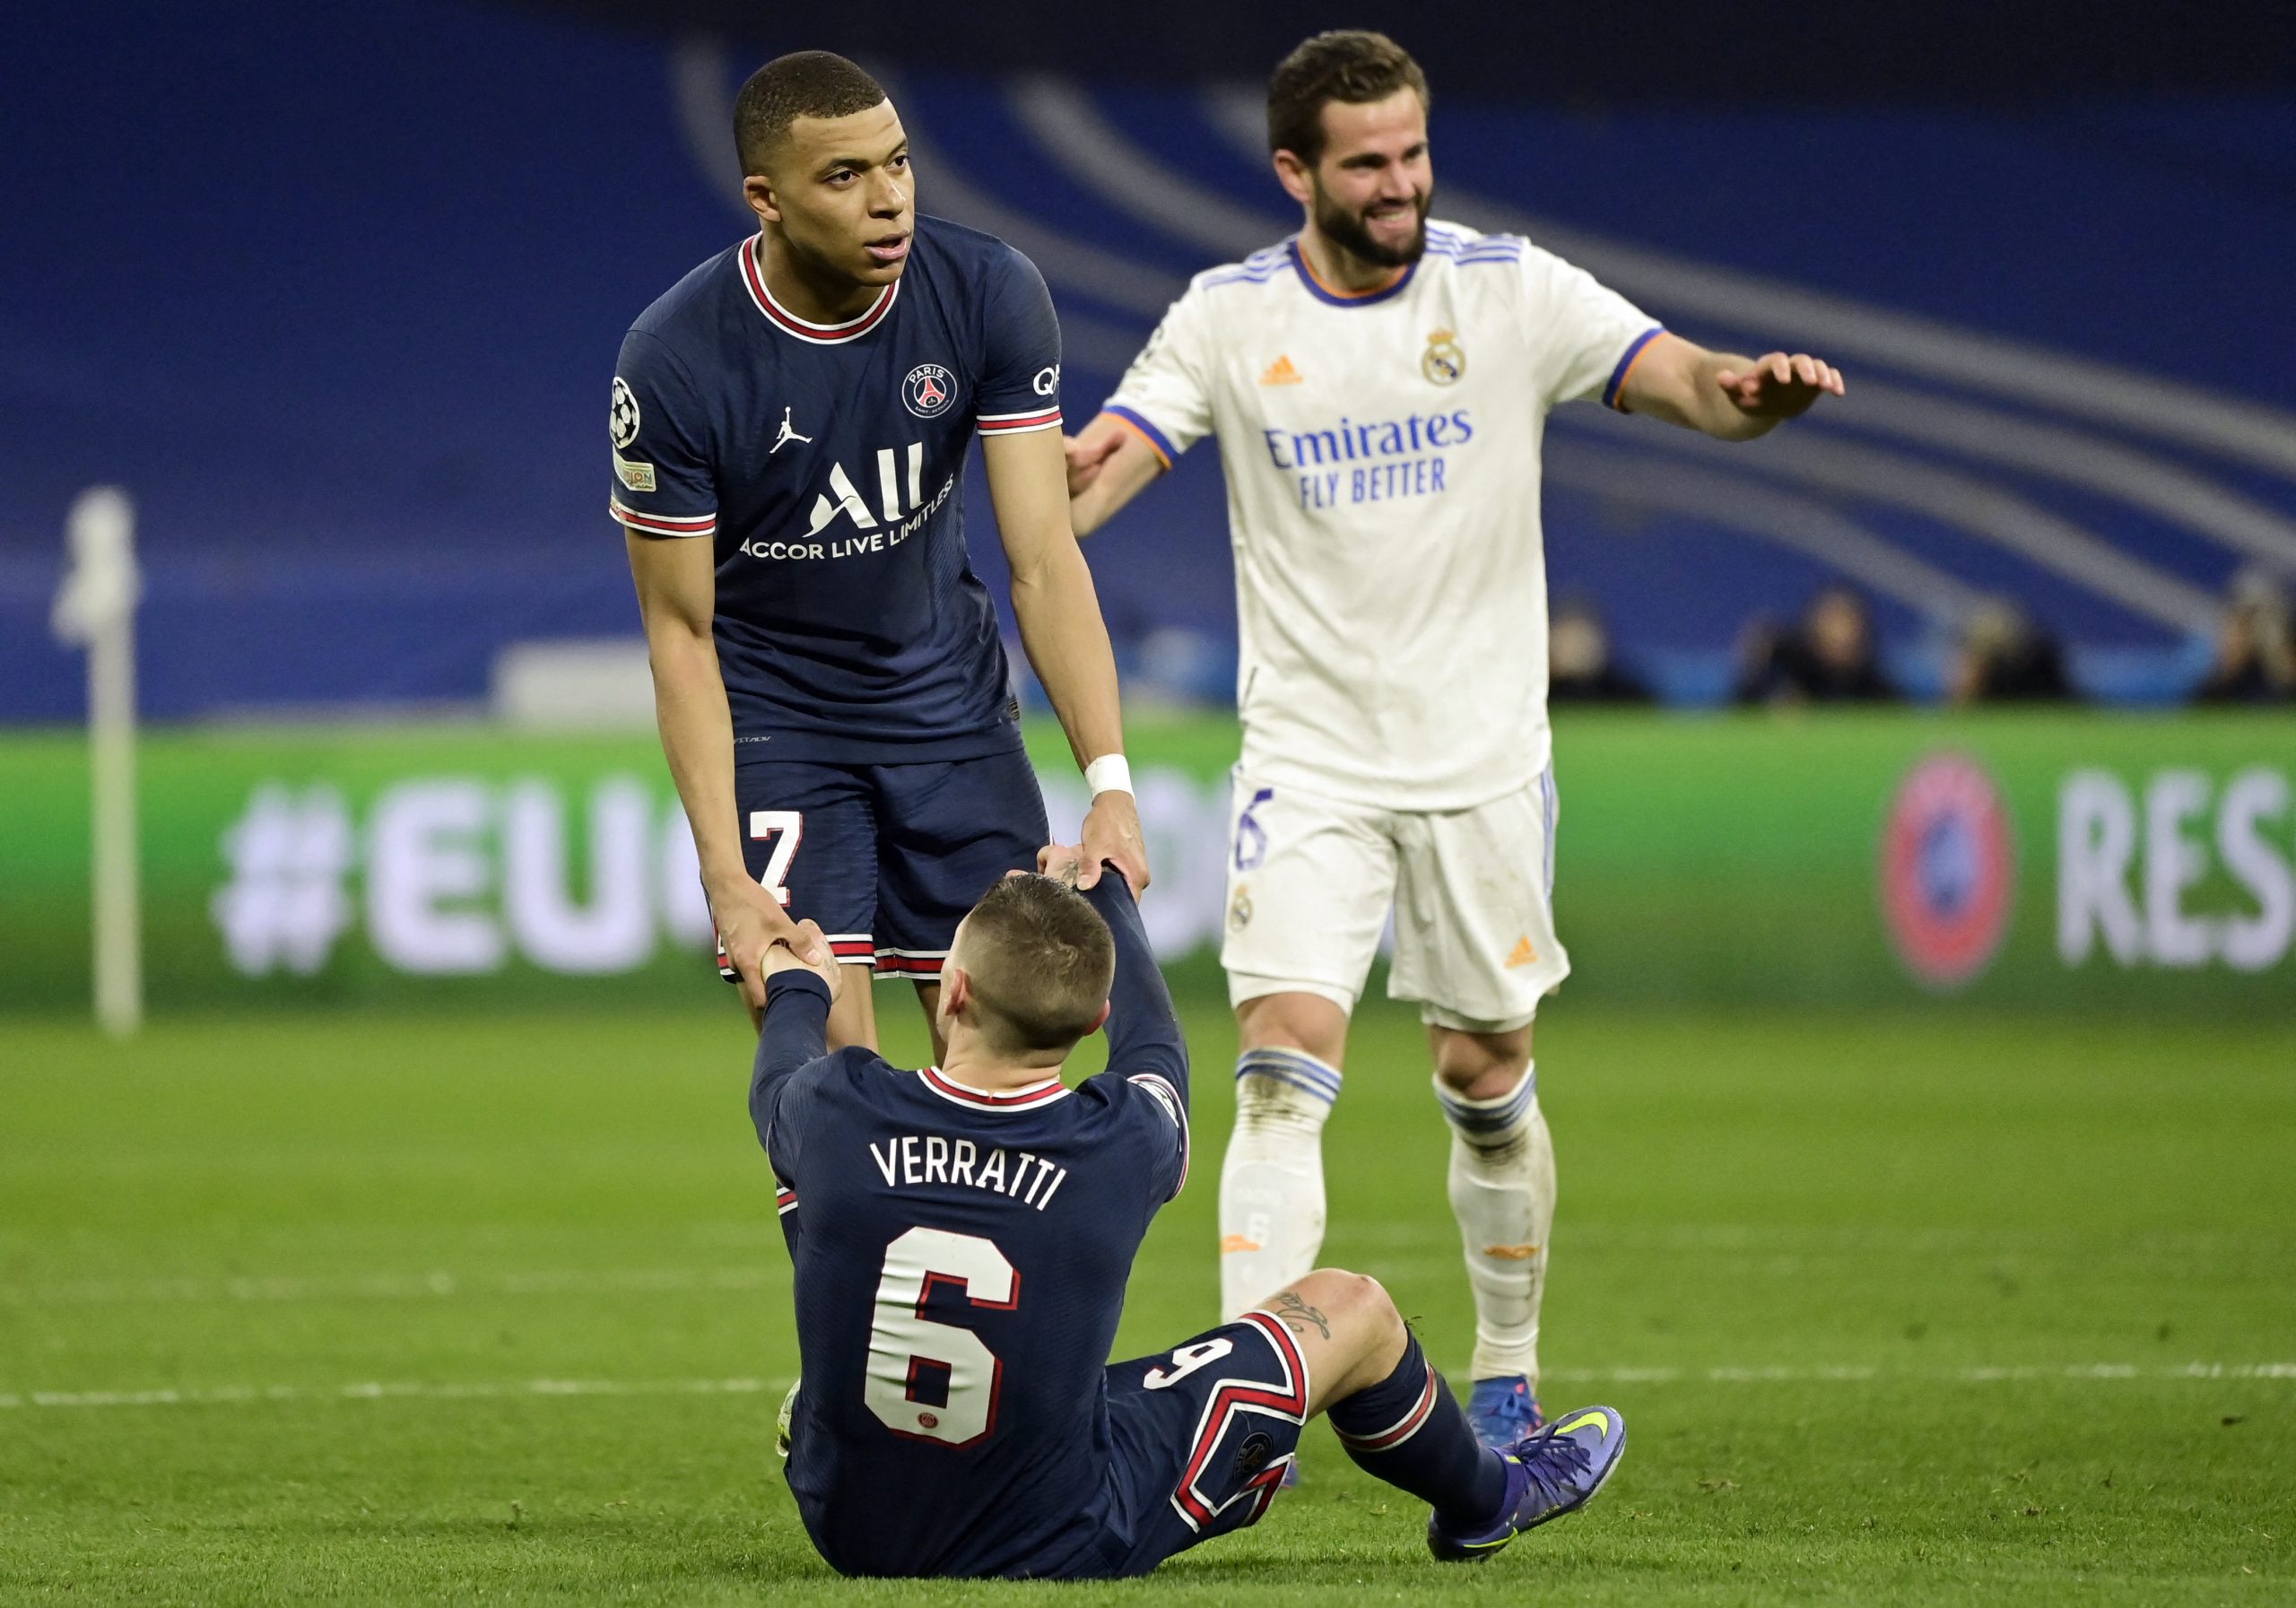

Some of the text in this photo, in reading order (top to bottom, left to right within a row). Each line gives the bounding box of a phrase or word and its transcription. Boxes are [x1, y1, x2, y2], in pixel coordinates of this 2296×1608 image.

[909, 367, 944, 383] PARIS
[1264, 408, 1474, 469] Emirates
[1300, 457, 1447, 511] FLY BETTER
[739, 537, 825, 560] ACCOR
[831, 533, 885, 559] LIVE
[750, 811, 804, 908] 7
[1236, 788, 1274, 872] 6
[869, 1135, 1066, 1211] VERRATTI
[864, 1226, 1021, 1449] 6
